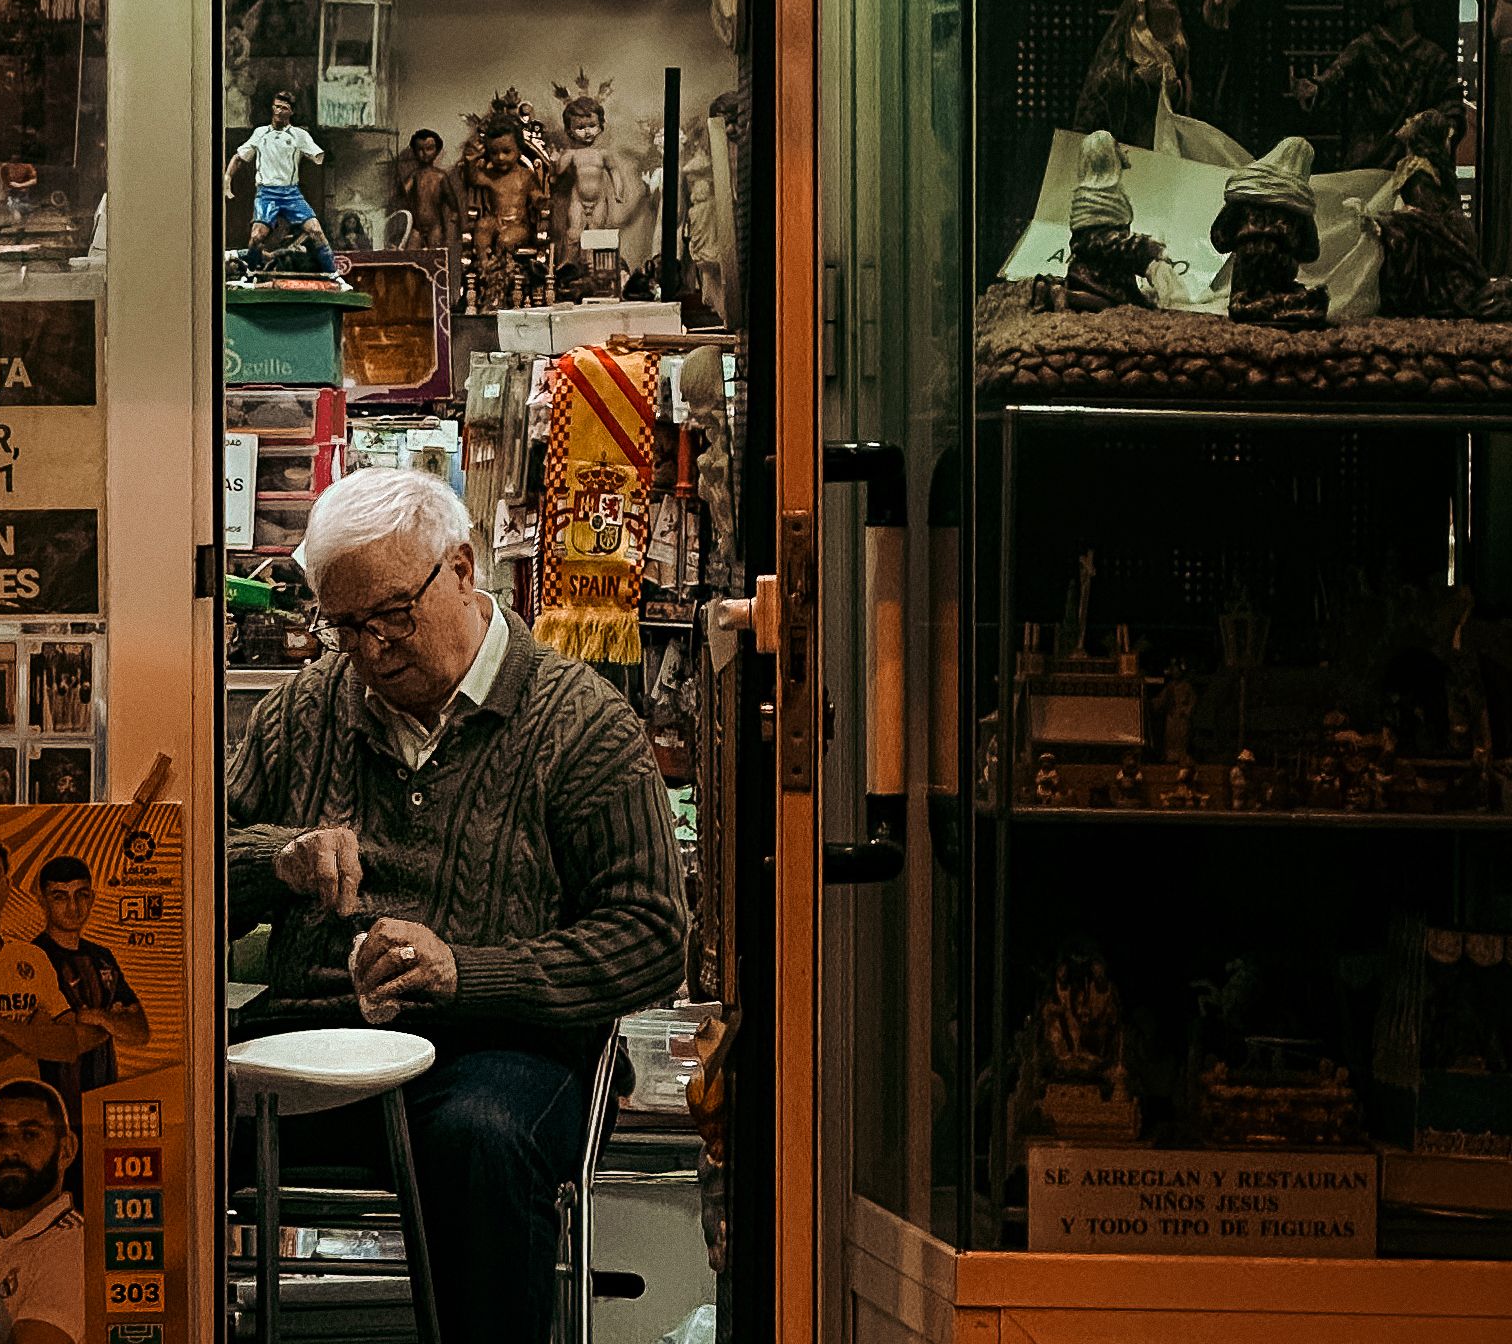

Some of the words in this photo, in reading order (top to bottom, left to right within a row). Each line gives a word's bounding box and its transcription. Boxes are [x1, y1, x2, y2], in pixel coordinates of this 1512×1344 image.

[569, 575, 620, 598] SPAIN
[113, 1156, 154, 1178] 101
[1044, 1169, 1071, 1187] SE
[1080, 1168, 1201, 1188] ARREGLAN
[1210, 1169, 1228, 1188] Y
[1237, 1170, 1369, 1190] RESTAURAN
[114, 1197, 155, 1220] 101
[1139, 1191, 1206, 1212] NIÑOS
[1215, 1193, 1279, 1213] JESUS
[1060, 1216, 1076, 1236] Y
[1086, 1217, 1149, 1236] TODO
[1159, 1218, 1209, 1236] TIPO
[1220, 1219, 1249, 1237] DE
[1260, 1219, 1356, 1239] FIGURAS
[114, 1241, 155, 1263] 101
[110, 1283, 160, 1304] 303
